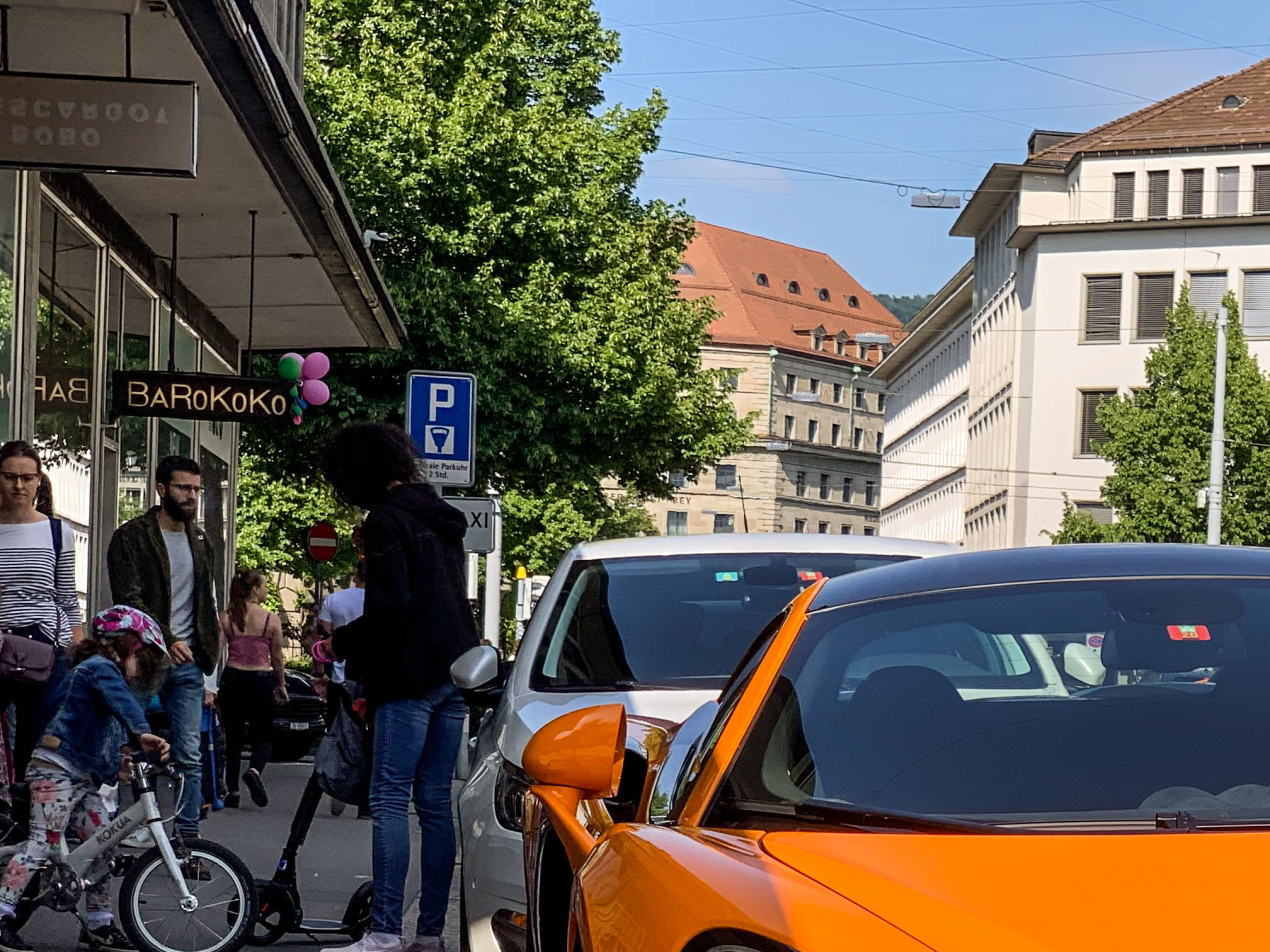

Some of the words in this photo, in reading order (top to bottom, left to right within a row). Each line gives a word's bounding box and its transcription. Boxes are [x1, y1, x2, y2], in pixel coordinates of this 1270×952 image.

[429, 383, 455, 421] P
[469, 512, 488, 528] XI
[96, 815, 132, 845] KOKUA
